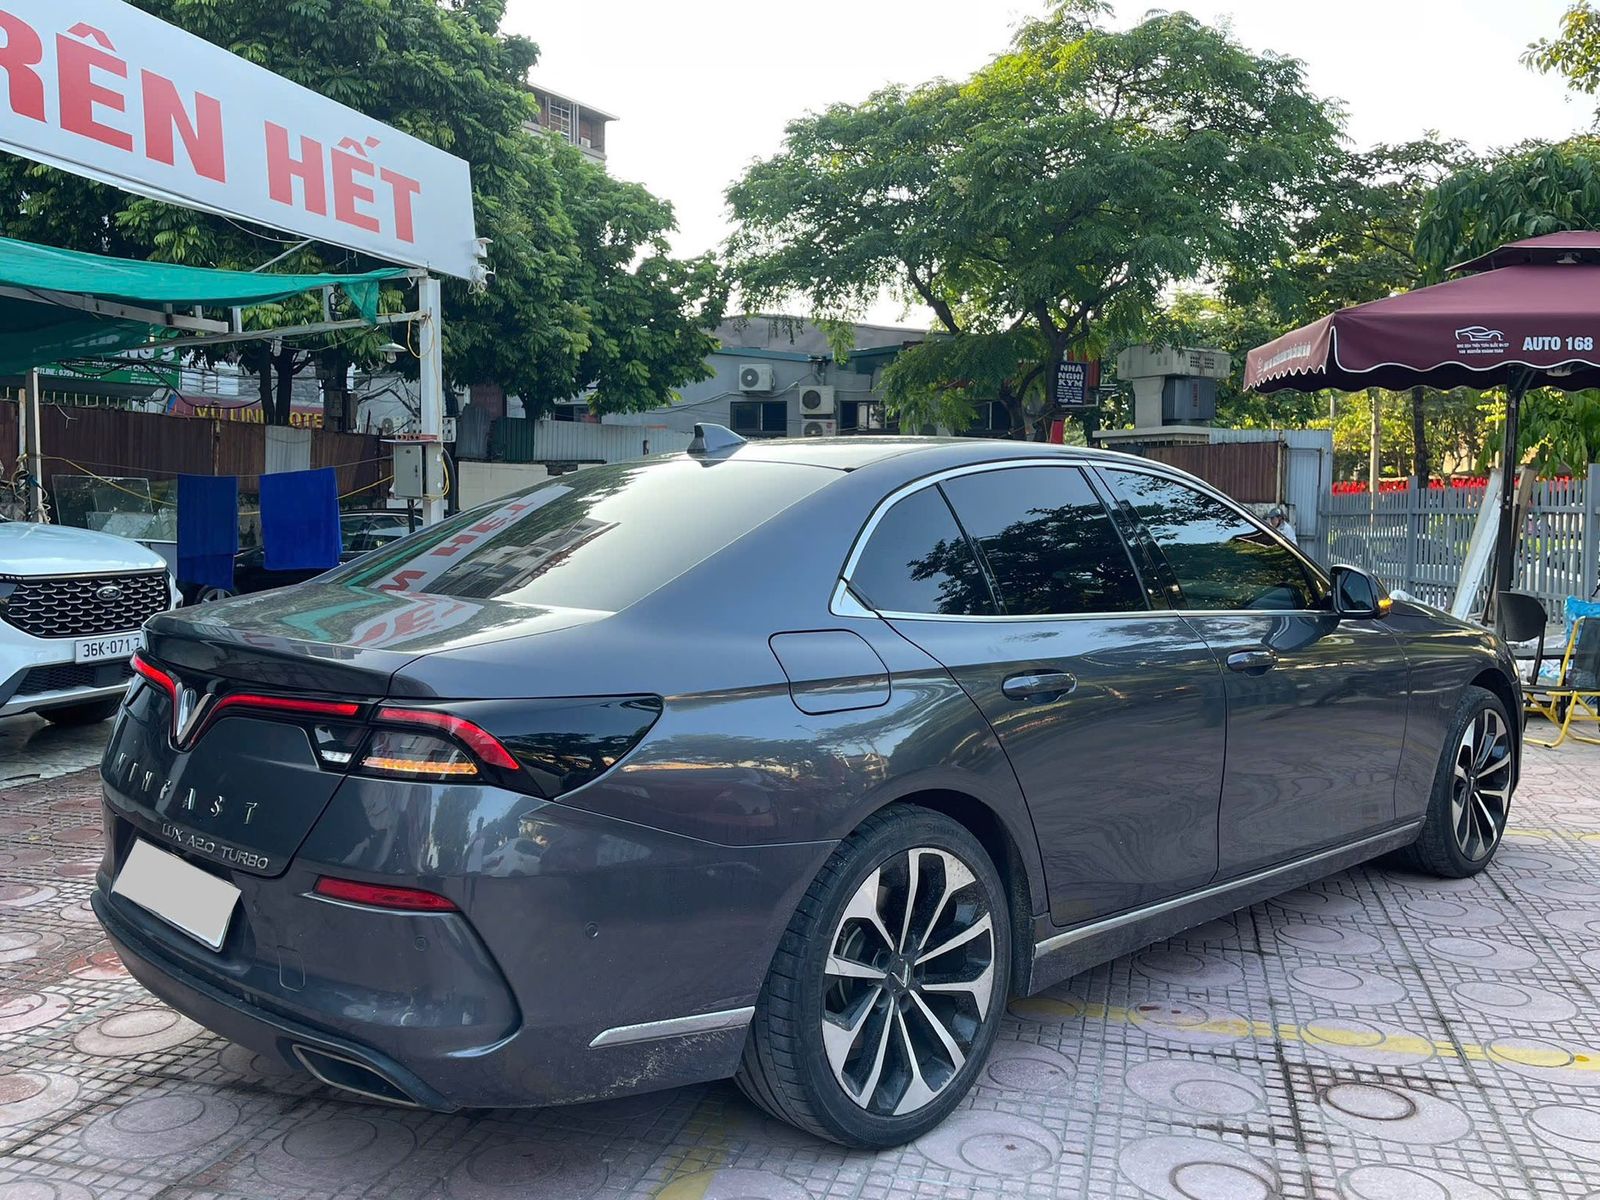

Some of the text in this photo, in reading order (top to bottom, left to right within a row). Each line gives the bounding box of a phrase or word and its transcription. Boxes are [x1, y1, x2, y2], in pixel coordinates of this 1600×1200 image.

[264, 120, 421, 244] HẾT
[1522, 336, 1593, 351] AUTO 168
[230, 408, 266, 424] LIN
[289, 412, 324, 429] OTE
[161, 822, 184, 843] LUX
[221, 845, 269, 870] TURBO
